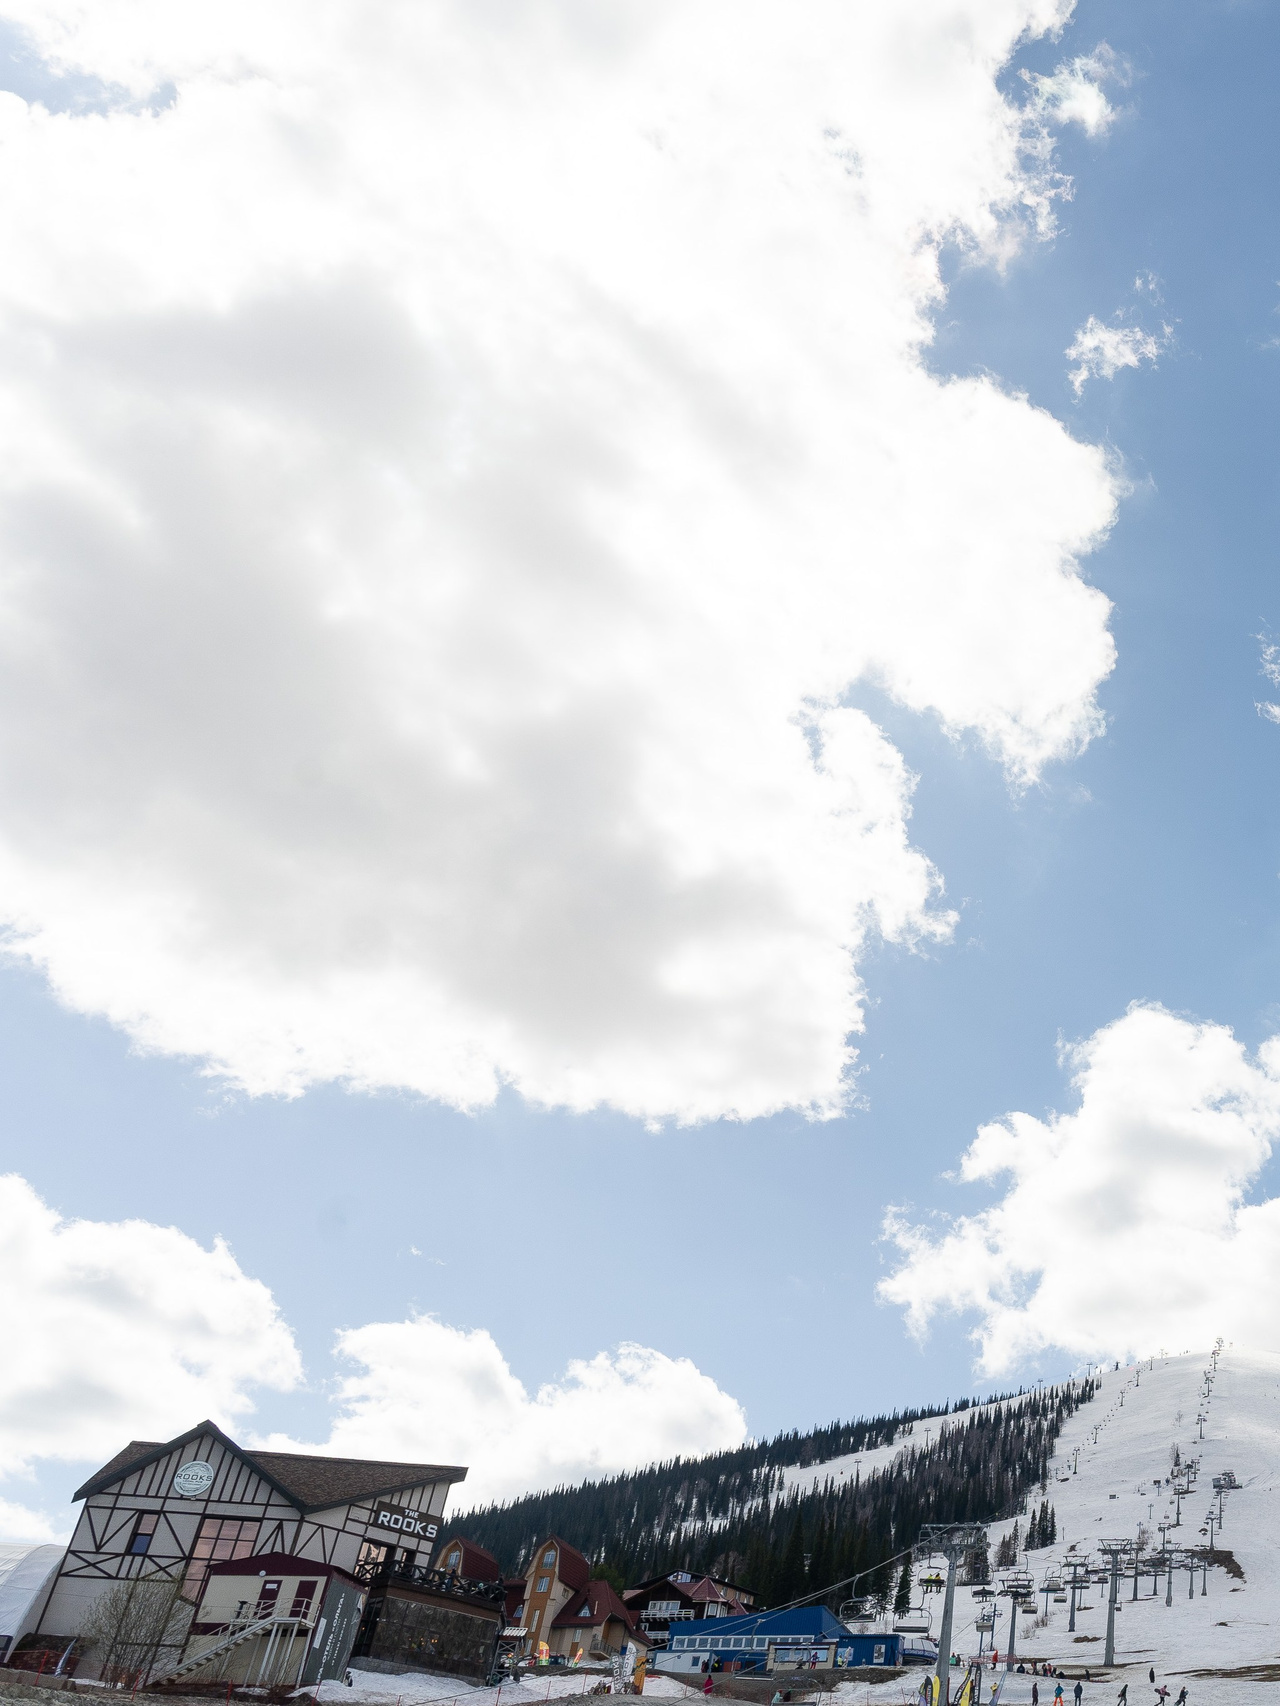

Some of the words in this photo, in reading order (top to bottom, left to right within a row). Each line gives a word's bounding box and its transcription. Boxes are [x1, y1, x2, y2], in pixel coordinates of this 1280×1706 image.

[176, 1473, 213, 1482] ROOKS
[404, 1509, 419, 1519] THE
[377, 1511, 438, 1538] ROOKS
